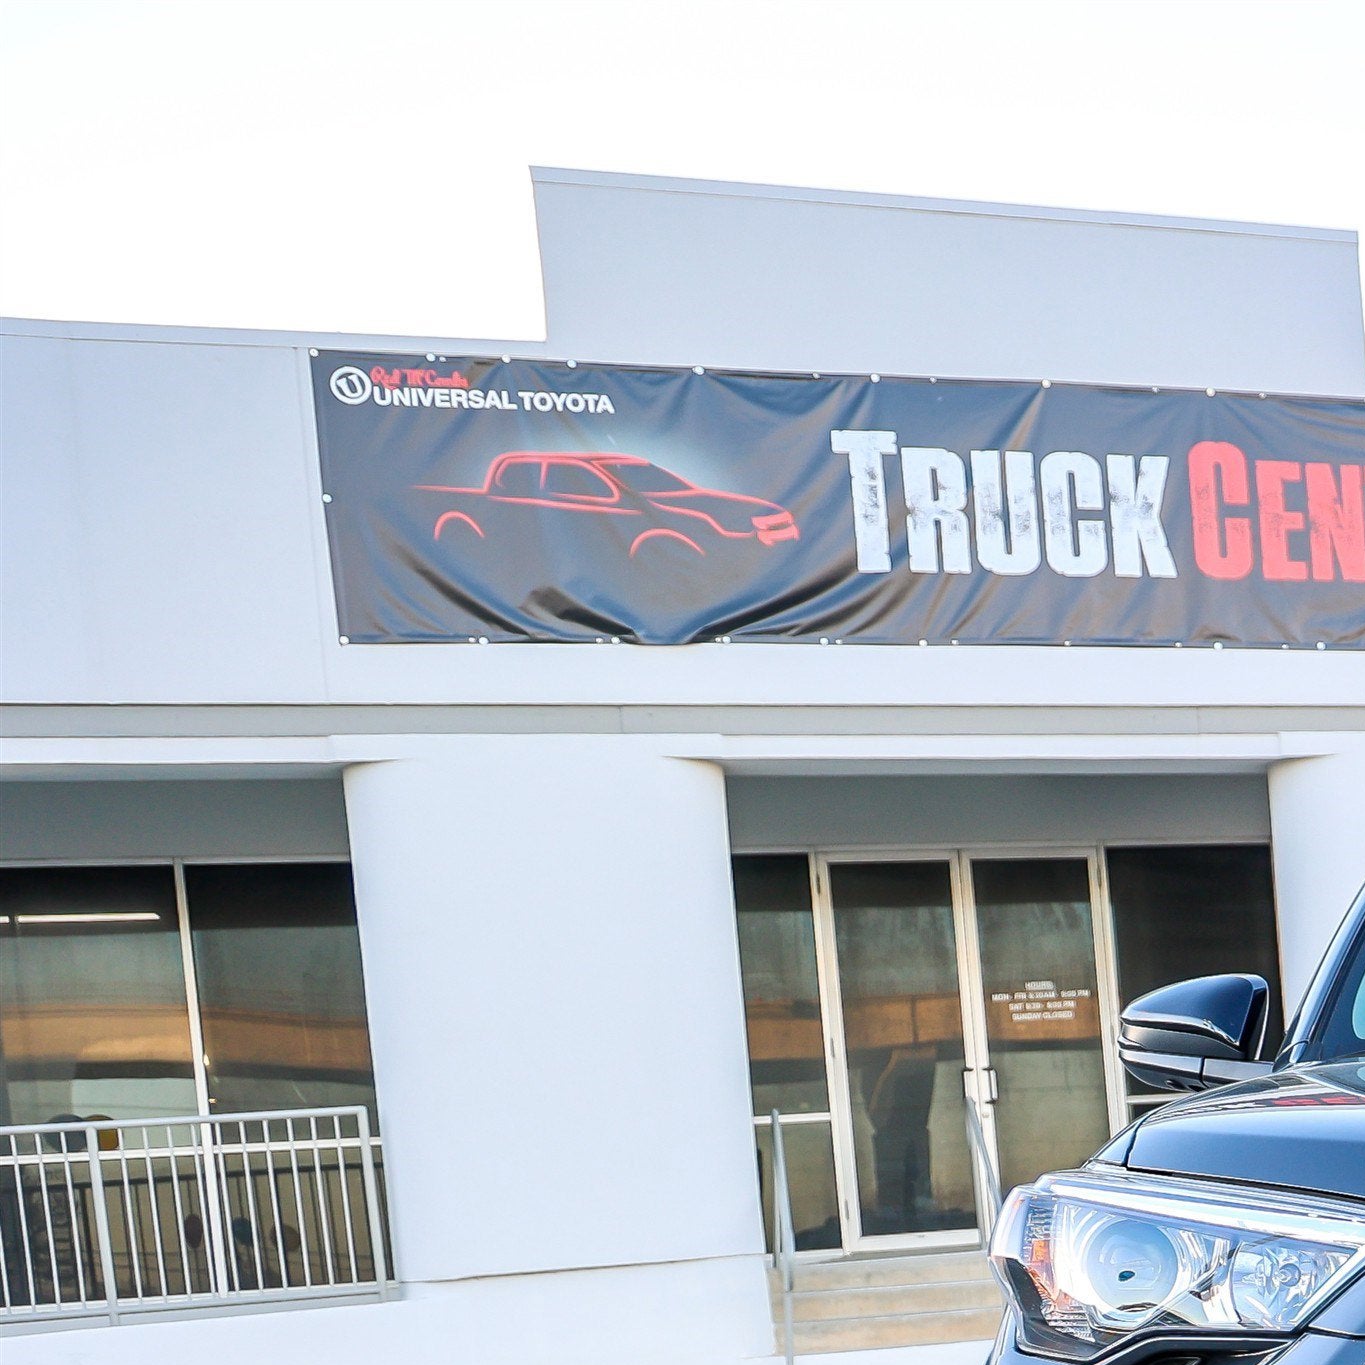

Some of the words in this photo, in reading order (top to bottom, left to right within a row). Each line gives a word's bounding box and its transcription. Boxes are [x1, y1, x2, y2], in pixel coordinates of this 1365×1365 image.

[373, 385, 518, 410] UNIVERSAL
[518, 391, 616, 414] TOYOTA
[830, 429, 1179, 580] TRUCK
